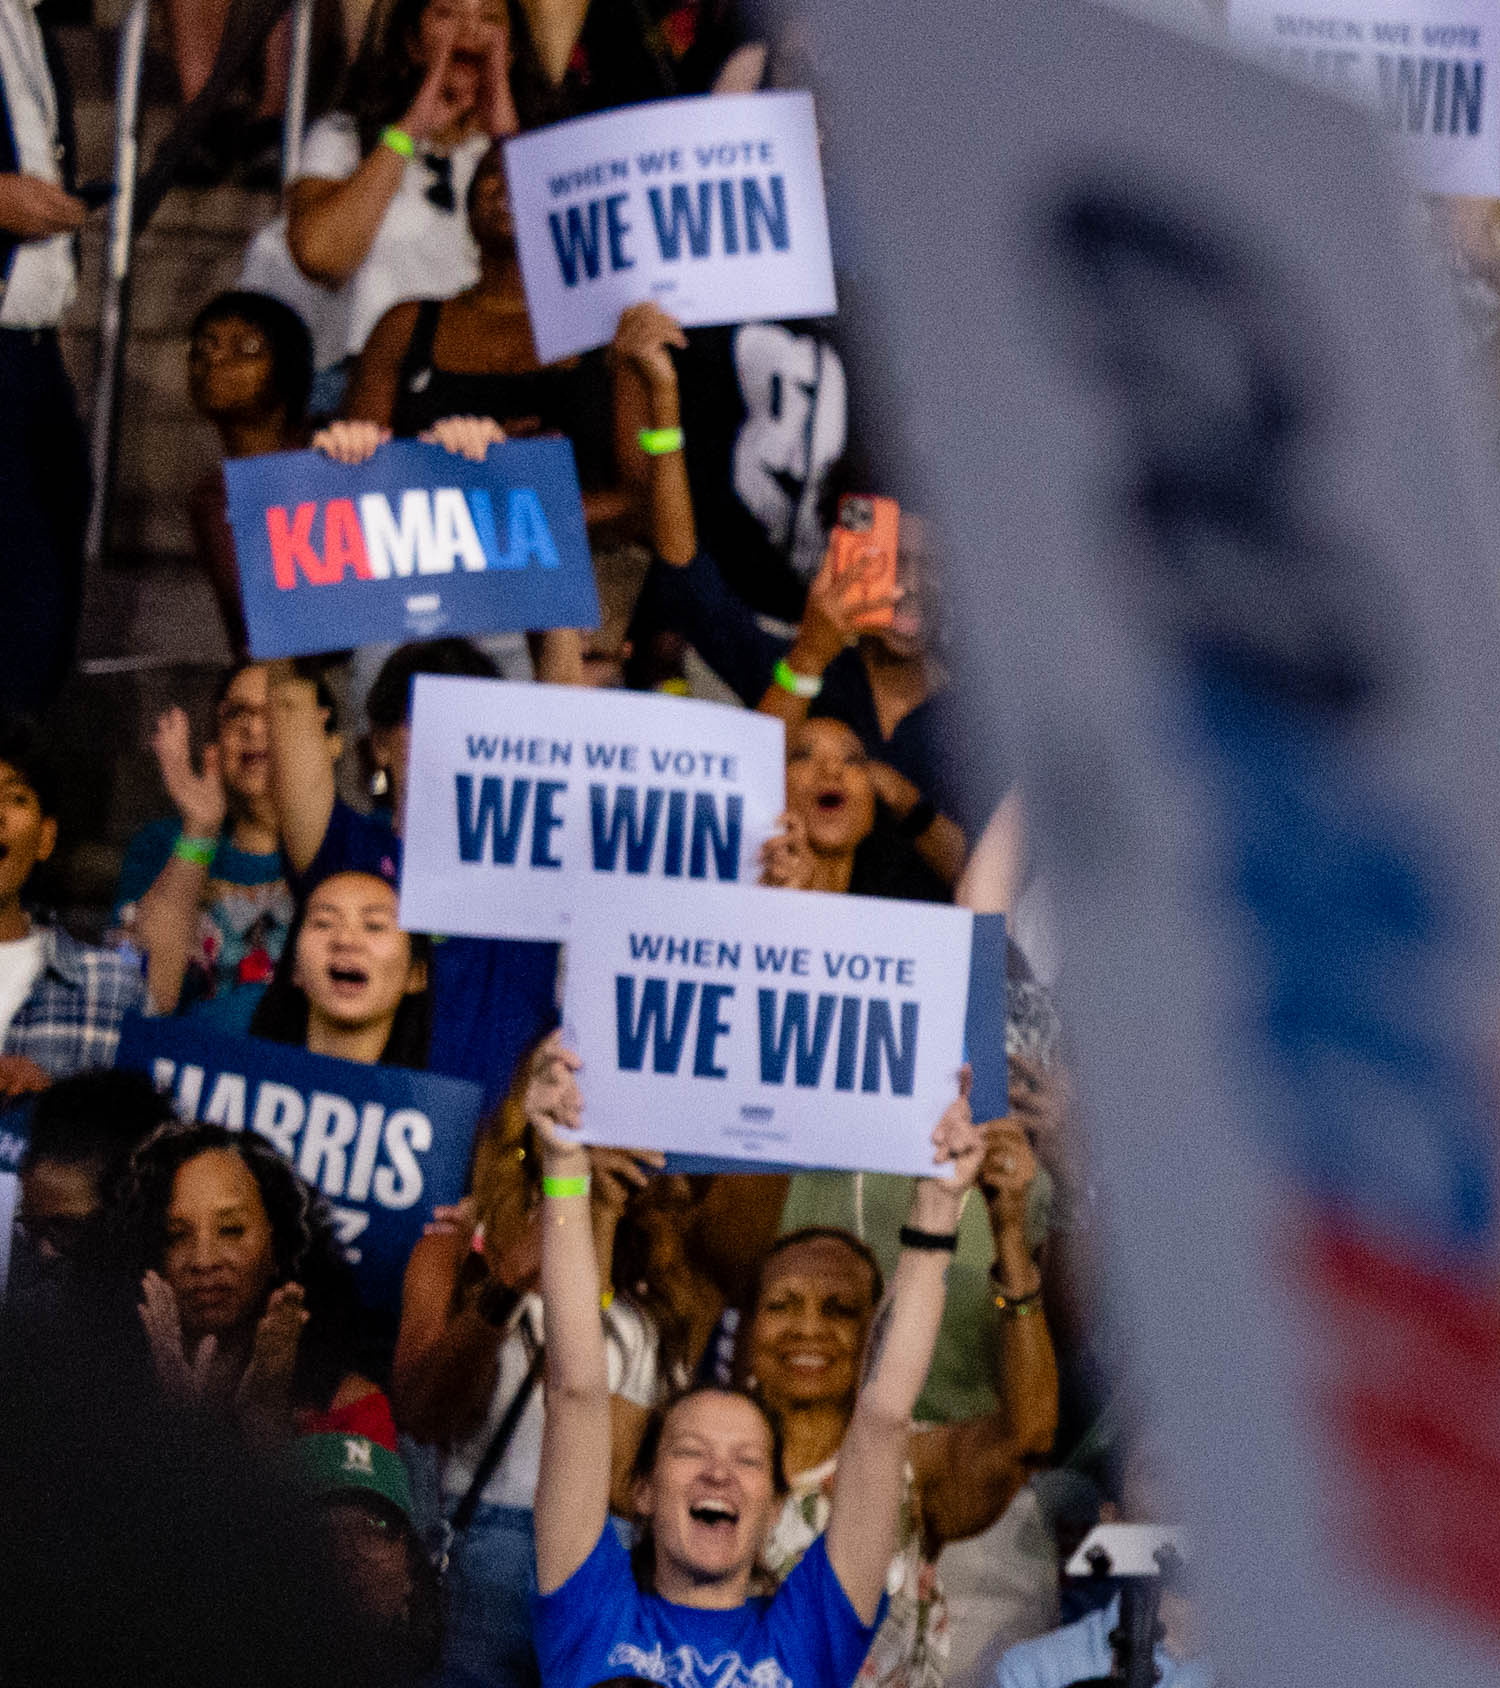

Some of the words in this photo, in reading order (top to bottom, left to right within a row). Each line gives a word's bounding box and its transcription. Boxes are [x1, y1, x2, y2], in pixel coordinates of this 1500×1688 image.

[636, 149, 682, 175] WE
[694, 140, 772, 168] VOTE
[549, 191, 635, 287] WE
[647, 174, 791, 262] WIN
[266, 487, 561, 590] KAMALA
[466, 734, 573, 766] WHEN
[584, 742, 639, 772] WE
[651, 748, 739, 780] VOTE
[455, 772, 569, 869] WE
[589, 783, 744, 882] WIN
[628, 932, 741, 970] WHEN
[754, 943, 811, 977] WE
[824, 950, 915, 986] VOTE
[615, 974, 735, 1080] WE
[758, 987, 920, 1098] WIN
